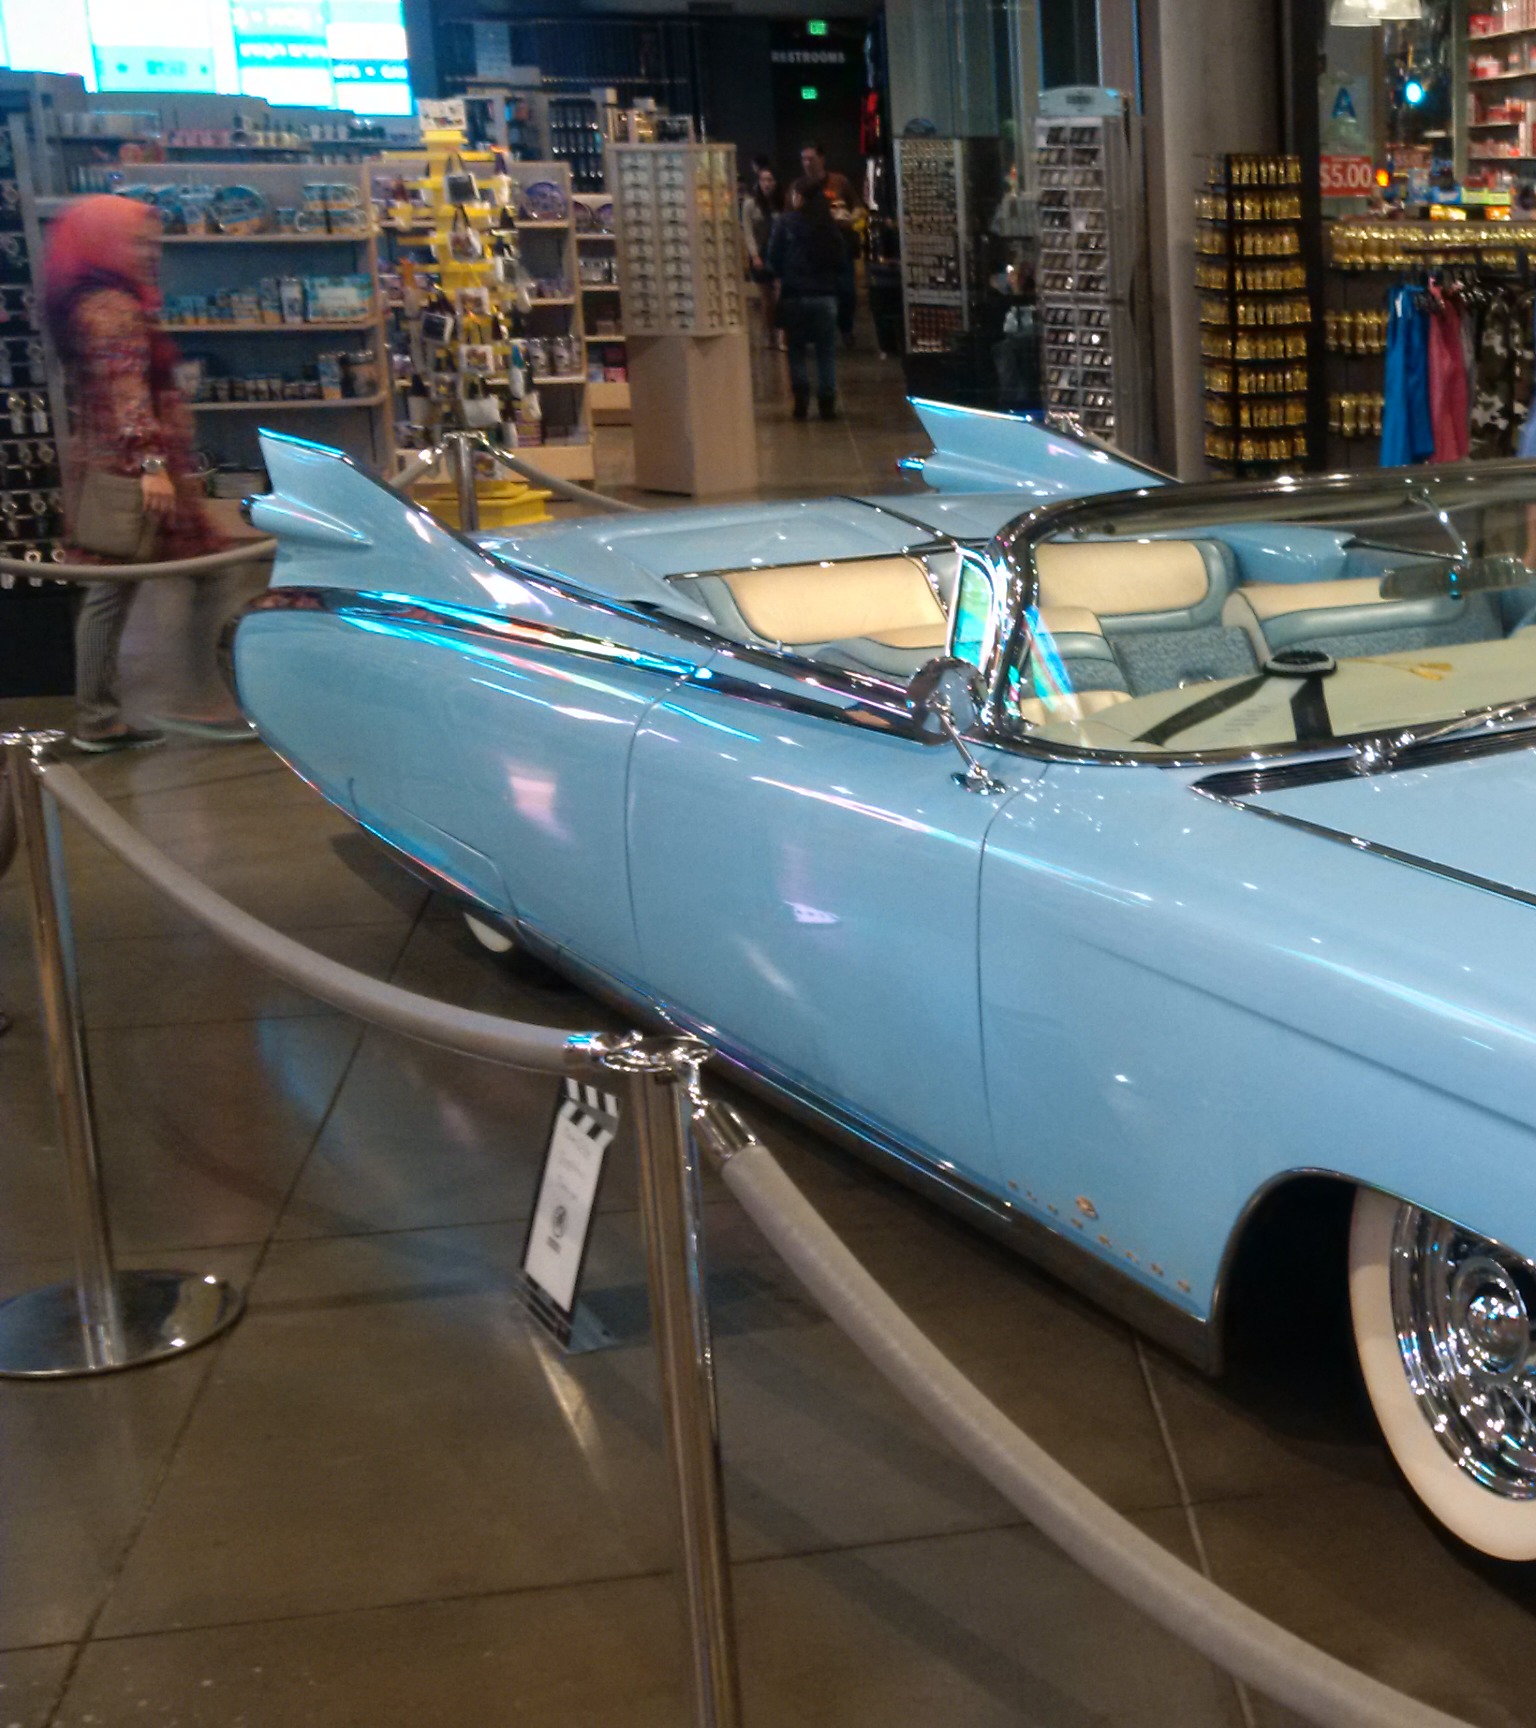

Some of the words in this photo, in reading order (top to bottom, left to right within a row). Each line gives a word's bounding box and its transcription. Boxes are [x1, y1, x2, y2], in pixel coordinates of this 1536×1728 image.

[771, 50, 845, 63] RESTROOMS
[1331, 86, 1356, 119] A
[1319, 162, 1371, 189] $5.00
